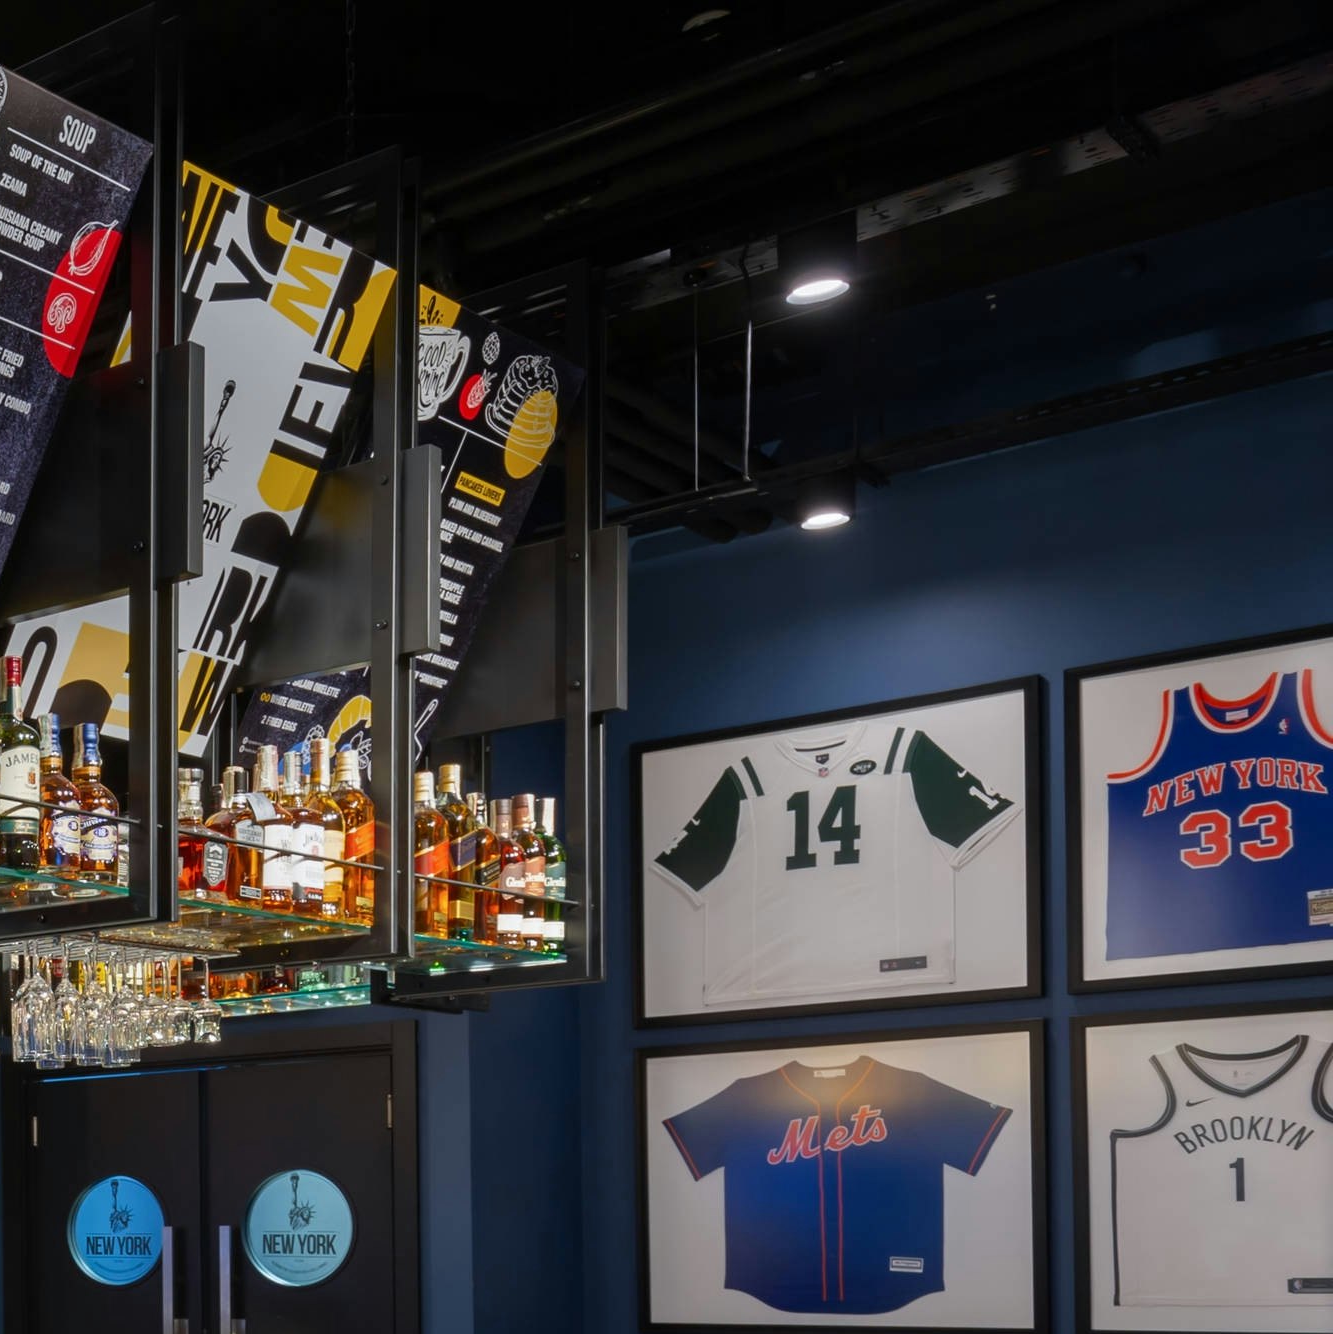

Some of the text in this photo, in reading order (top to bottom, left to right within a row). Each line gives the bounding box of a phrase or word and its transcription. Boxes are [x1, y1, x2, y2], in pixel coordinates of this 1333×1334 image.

[59, 115, 96, 153] SOUP
[9, 144, 74, 185] SOUP OF THE DAY
[0, 172, 28, 197] ZEAMA
[23, 233, 45, 252] SOUP
[30, 221, 63, 245] CREAMY
[1, 349, 25, 367] FRIED
[4, 395, 32, 415] COMBO
[1143, 757, 1329, 817] NEW YORK
[786, 784, 862, 871] 14
[1180, 801, 1294, 869] 33
[767, 1105, 887, 1165] Mets
[1174, 1115, 1314, 1154] BROOKLYN
[1229, 1157, 1245, 1202] 1
[86, 1236, 152, 1256] NEW YORK
[262, 1234, 336, 1255] NEW YORK
